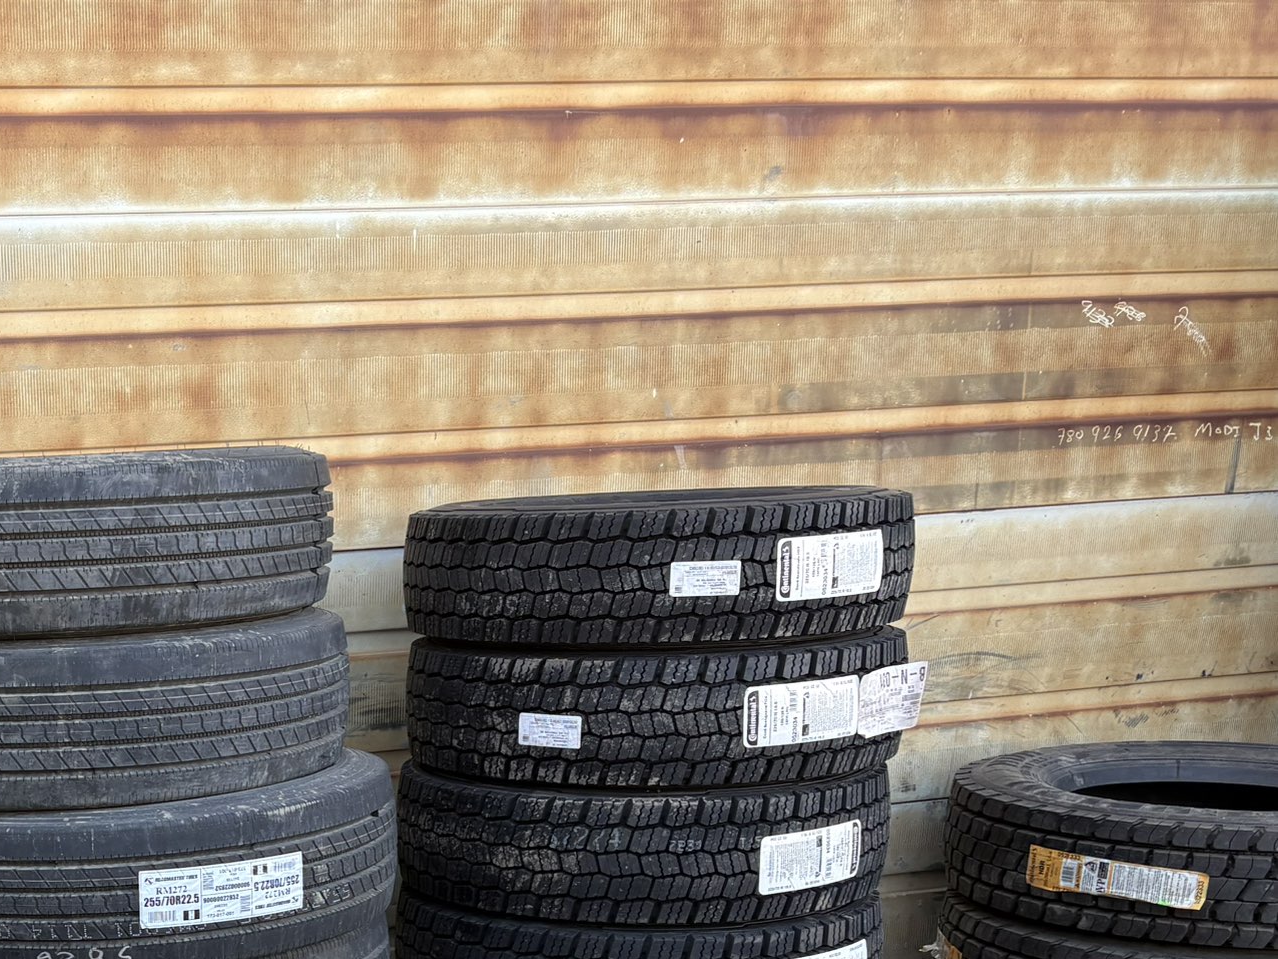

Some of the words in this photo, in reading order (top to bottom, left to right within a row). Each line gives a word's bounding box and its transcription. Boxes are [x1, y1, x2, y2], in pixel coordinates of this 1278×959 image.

[1058, 427, 1084, 445] 780
[1091, 425, 1123, 442] 926
[156, 885, 187, 895] RM272
[253, 874, 300, 892] 255/70R22.5
[143, 894, 200, 908] 255/70R22.5
